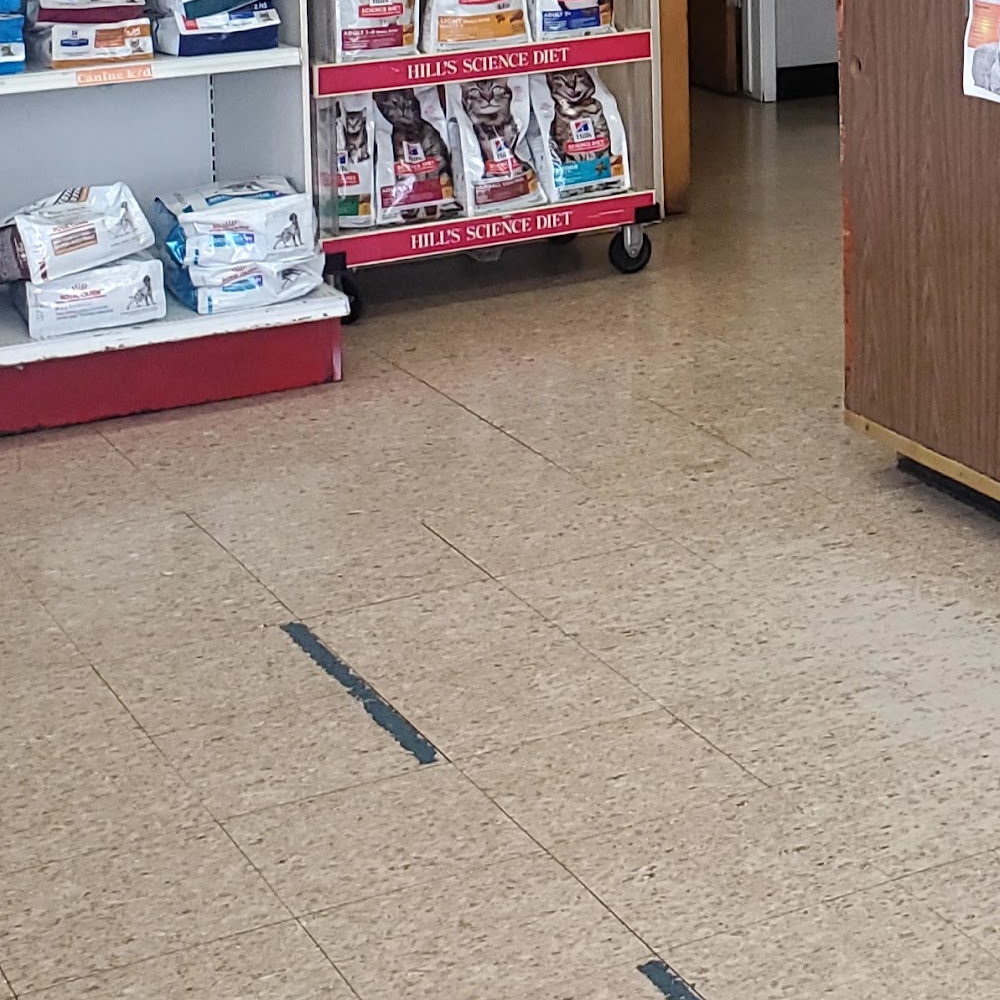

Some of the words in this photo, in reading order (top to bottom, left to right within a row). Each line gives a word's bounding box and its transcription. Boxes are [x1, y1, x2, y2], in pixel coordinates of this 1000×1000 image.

[127, 68, 152, 80] k/d
[407, 60, 458, 80] HILL'S
[462, 52, 529, 74] SCIENCE
[533, 47, 571, 65] DIET
[410, 228, 461, 249] HILL'S
[466, 218, 532, 242] SCIENCE
[536, 211, 573, 230] DIET
